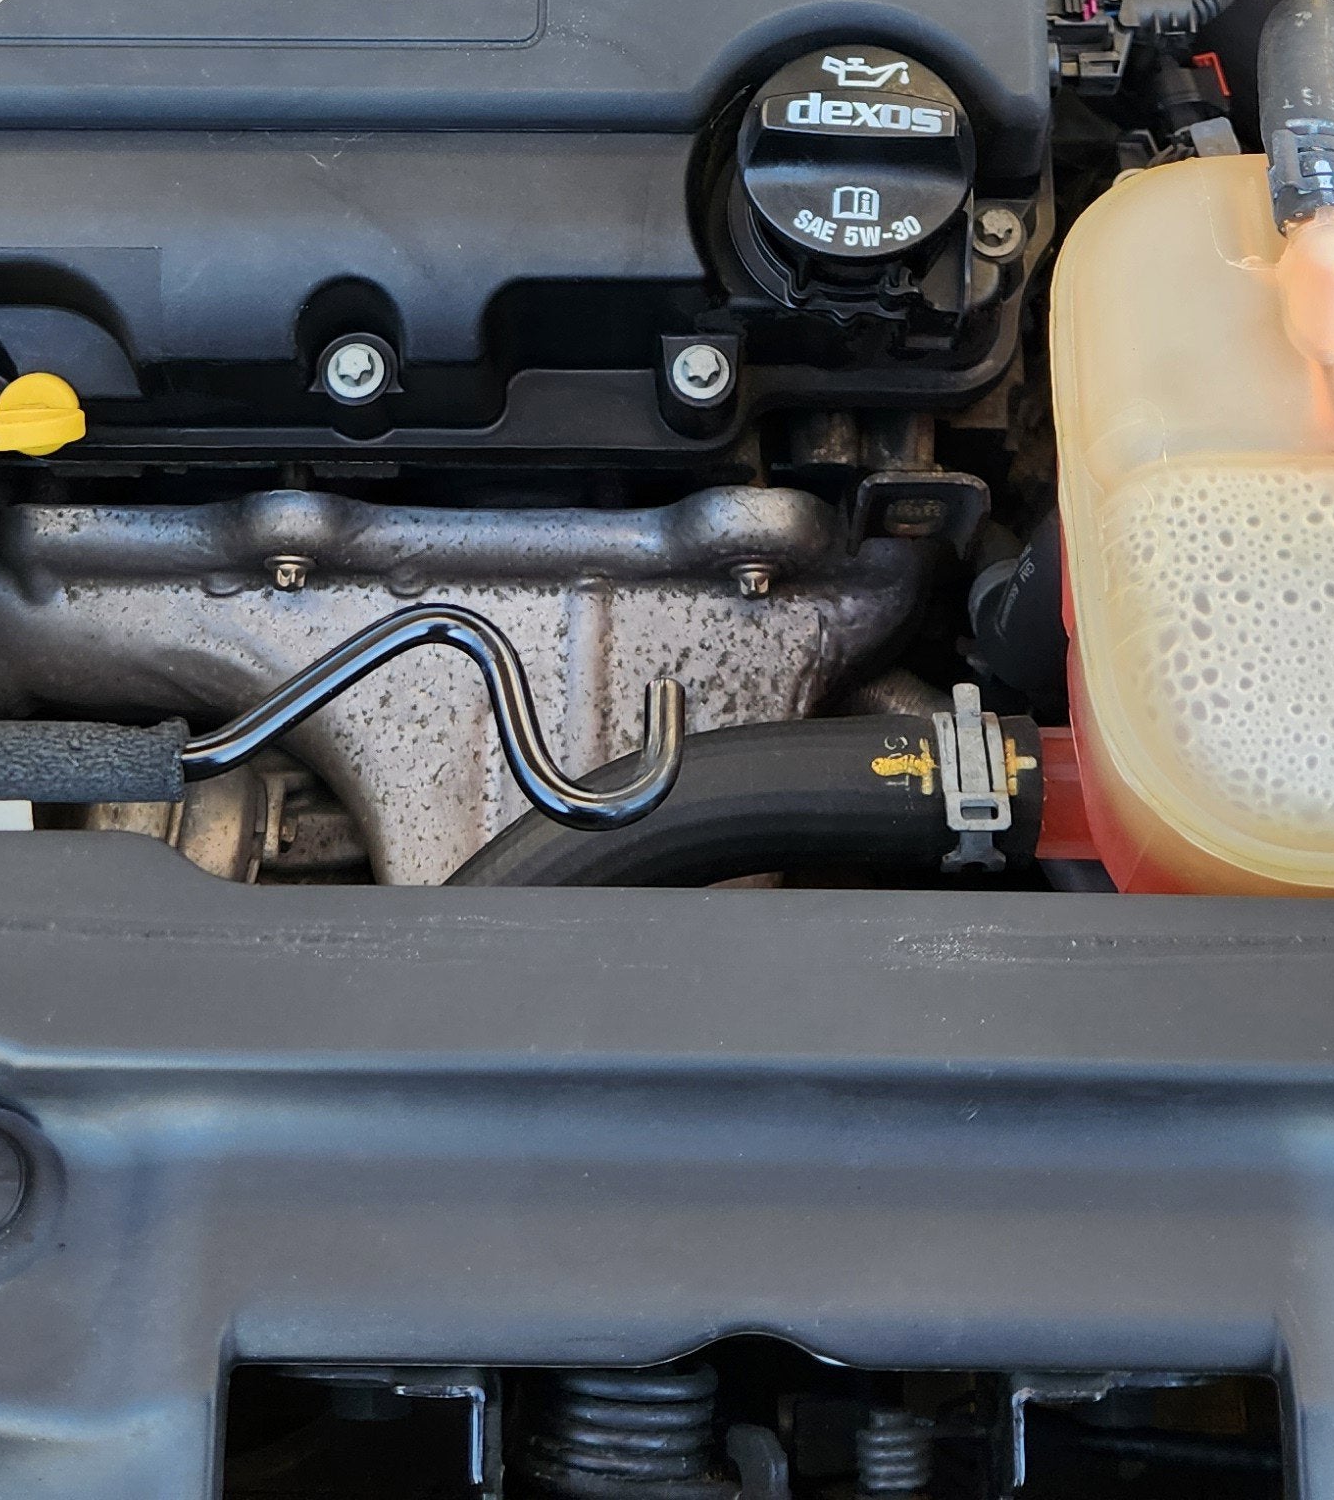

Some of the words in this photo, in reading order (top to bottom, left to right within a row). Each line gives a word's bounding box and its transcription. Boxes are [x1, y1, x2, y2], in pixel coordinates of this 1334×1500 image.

[786, 92, 943, 134] dexos
[793, 209, 837, 243] SAE
[843, 215, 922, 248] 5W-30
